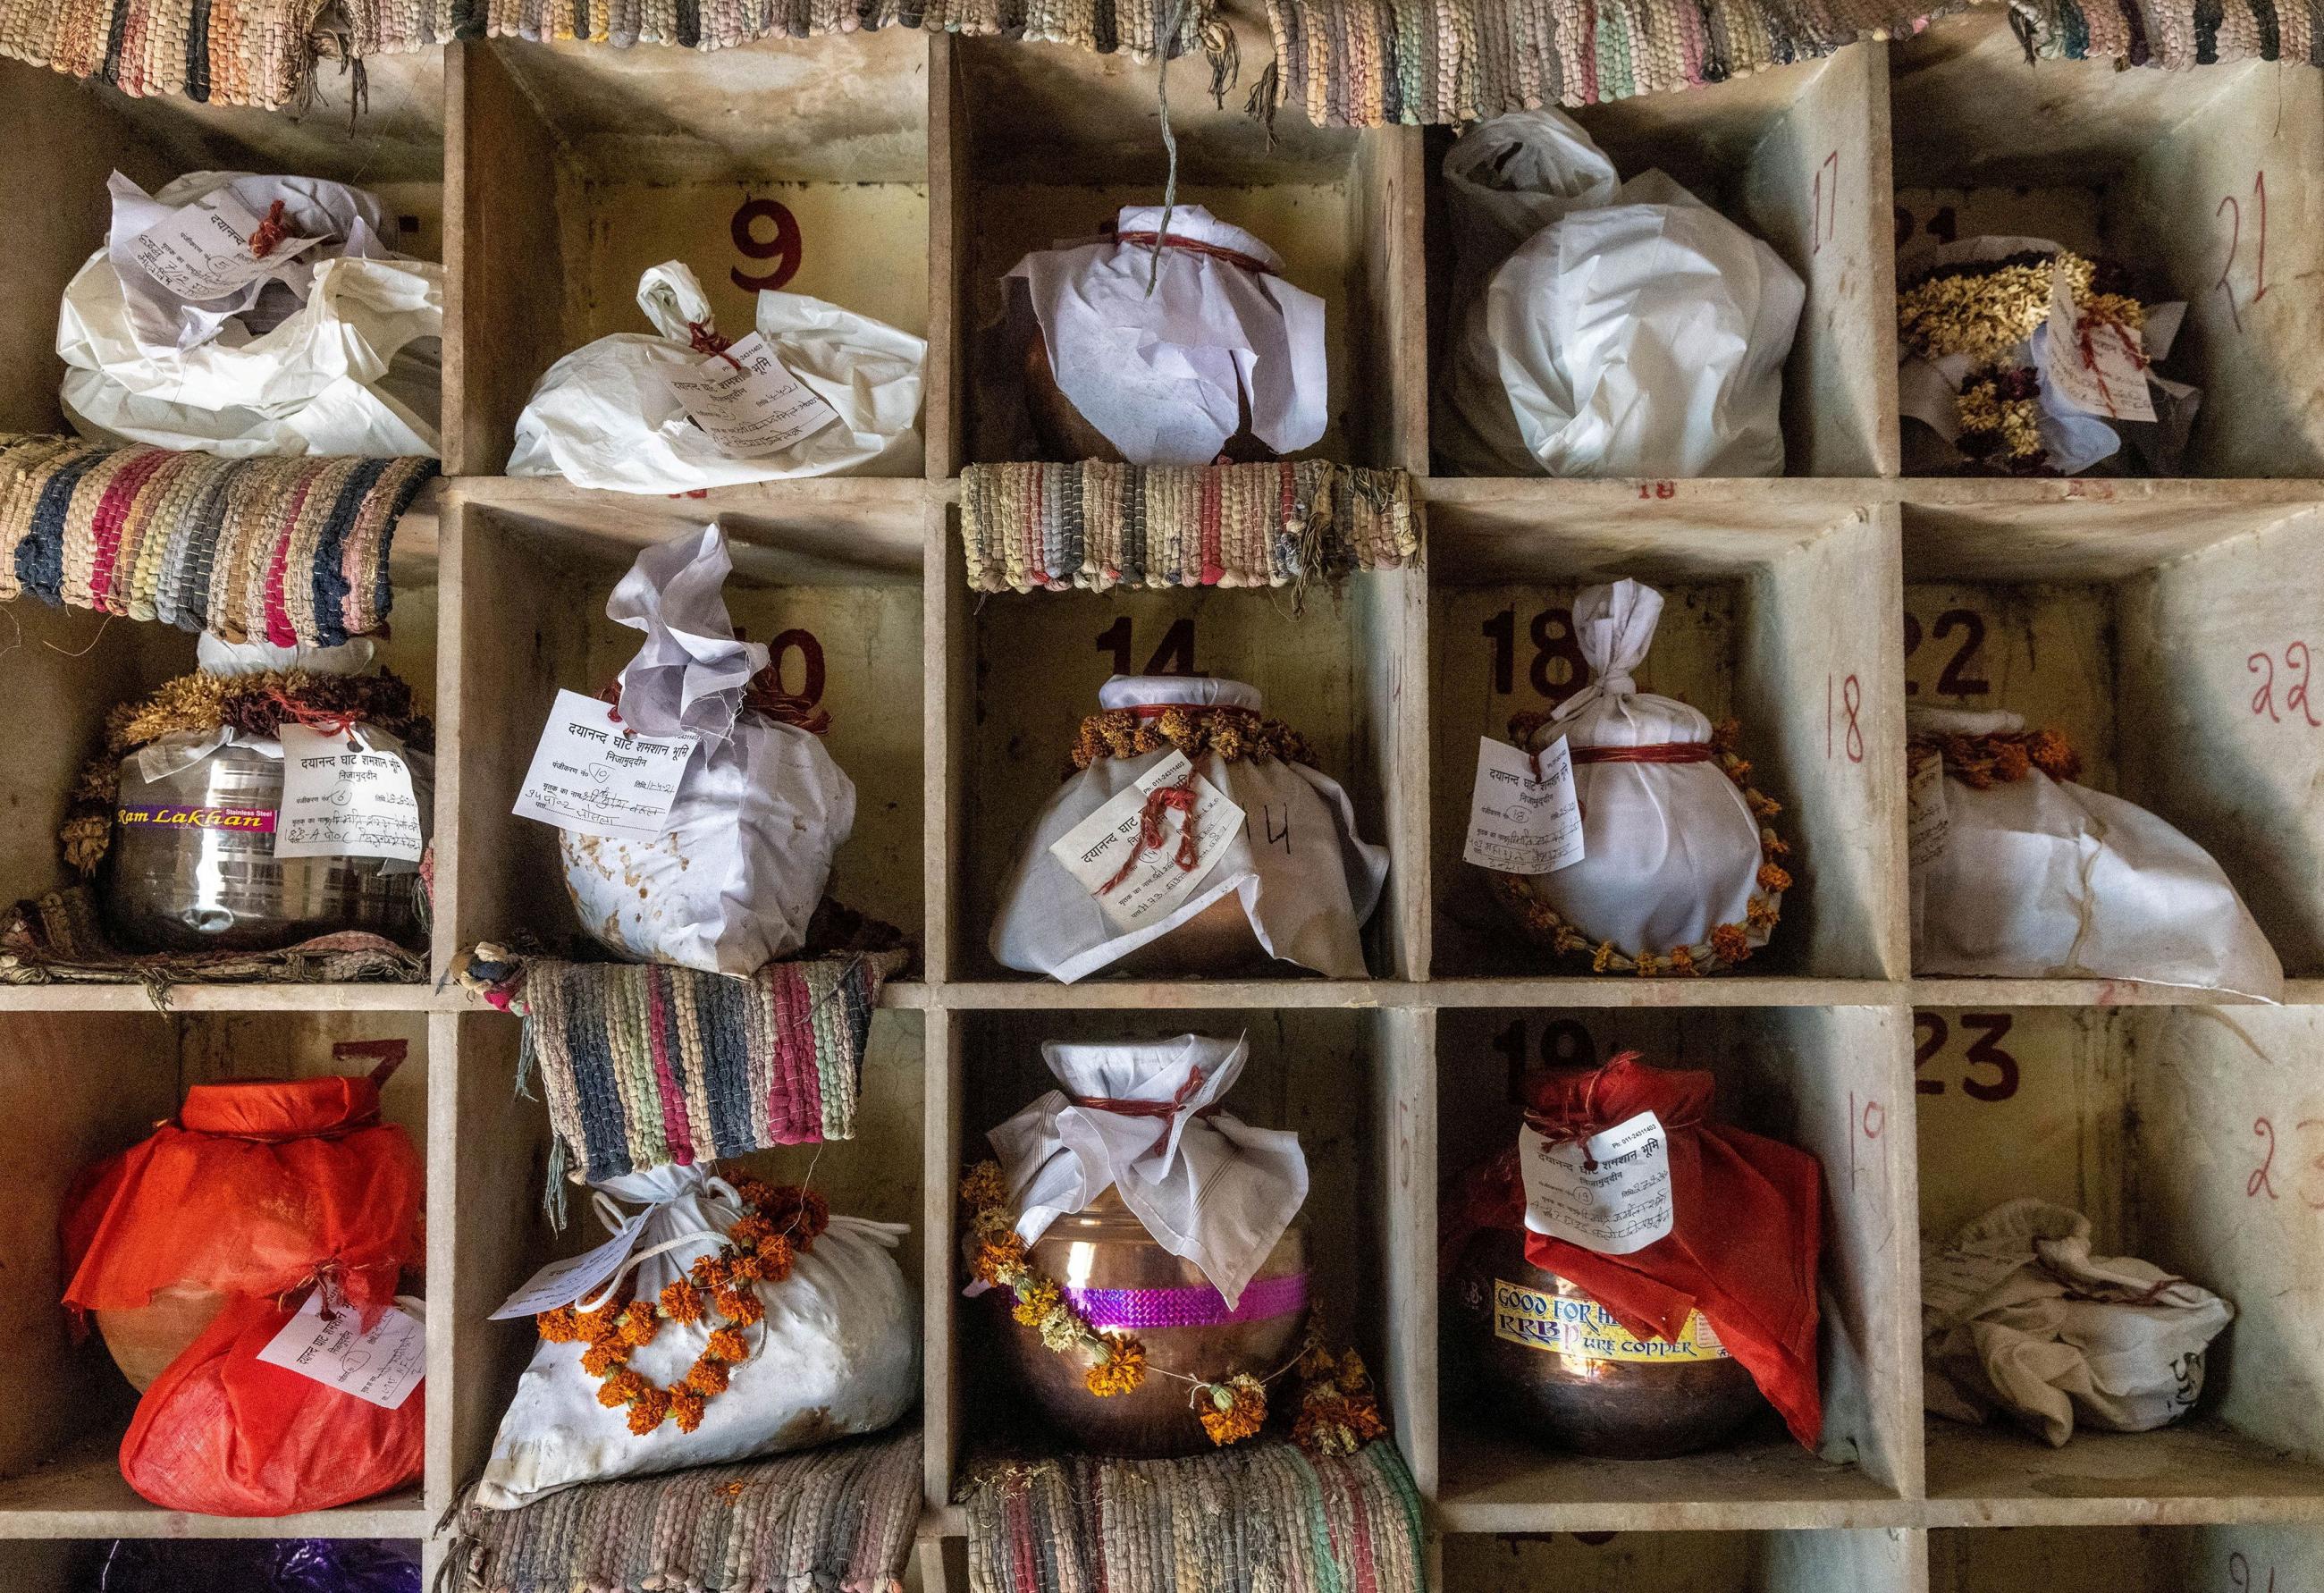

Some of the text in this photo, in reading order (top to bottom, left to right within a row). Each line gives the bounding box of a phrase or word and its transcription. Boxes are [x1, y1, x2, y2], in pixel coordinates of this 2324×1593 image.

[1813, 149, 1838, 256] 17
[211, 215, 246, 246] दयानन्द
[729, 198, 803, 292] 9
[2215, 170, 2268, 334] 21
[1097, 616, 1209, 677] 14
[1482, 608, 1588, 700] 18
[2247, 640, 2322, 728] 22
[1827, 672, 1864, 764] 18
[568, 722, 689, 761] दयानन्द घाट शमशान भूमि
[301, 756, 335, 769] दयानन्द
[341, 754, 357, 766] घाट
[362, 755, 387, 768] शमशान
[552, 761, 577, 774] पंजीकरण
[634, 780, 646, 789] तिथि
[1143, 761, 1185, 795] Ph: 011-24311403
[543, 782, 558, 793] मृतक
[570, 789, 582, 798] नाम
[1490, 769, 1520, 787] दयानन्द
[1524, 778, 1537, 792] घाट
[118, 809, 263, 827] Ram Lakhan
[225, 808, 255, 816] Stainless
[1081, 832, 1118, 864] दयानन्द
[1117, 815, 1138, 835] घाट
[1118, 893, 1133, 906] मृतक
[1133, 887, 1141, 895] का
[1621, 1124, 1656, 1144] 011-24311403
[1537, 1152, 1573, 1172] दयानन्द
[1602, 1150, 1638, 1170] शमशान
[1641, 1138, 1660, 1159] भूमि
[1499, 1313, 1560, 1345] RRB
[1554, 1299, 1599, 1335] FOR
[313, 1334, 328, 1347] घाट
